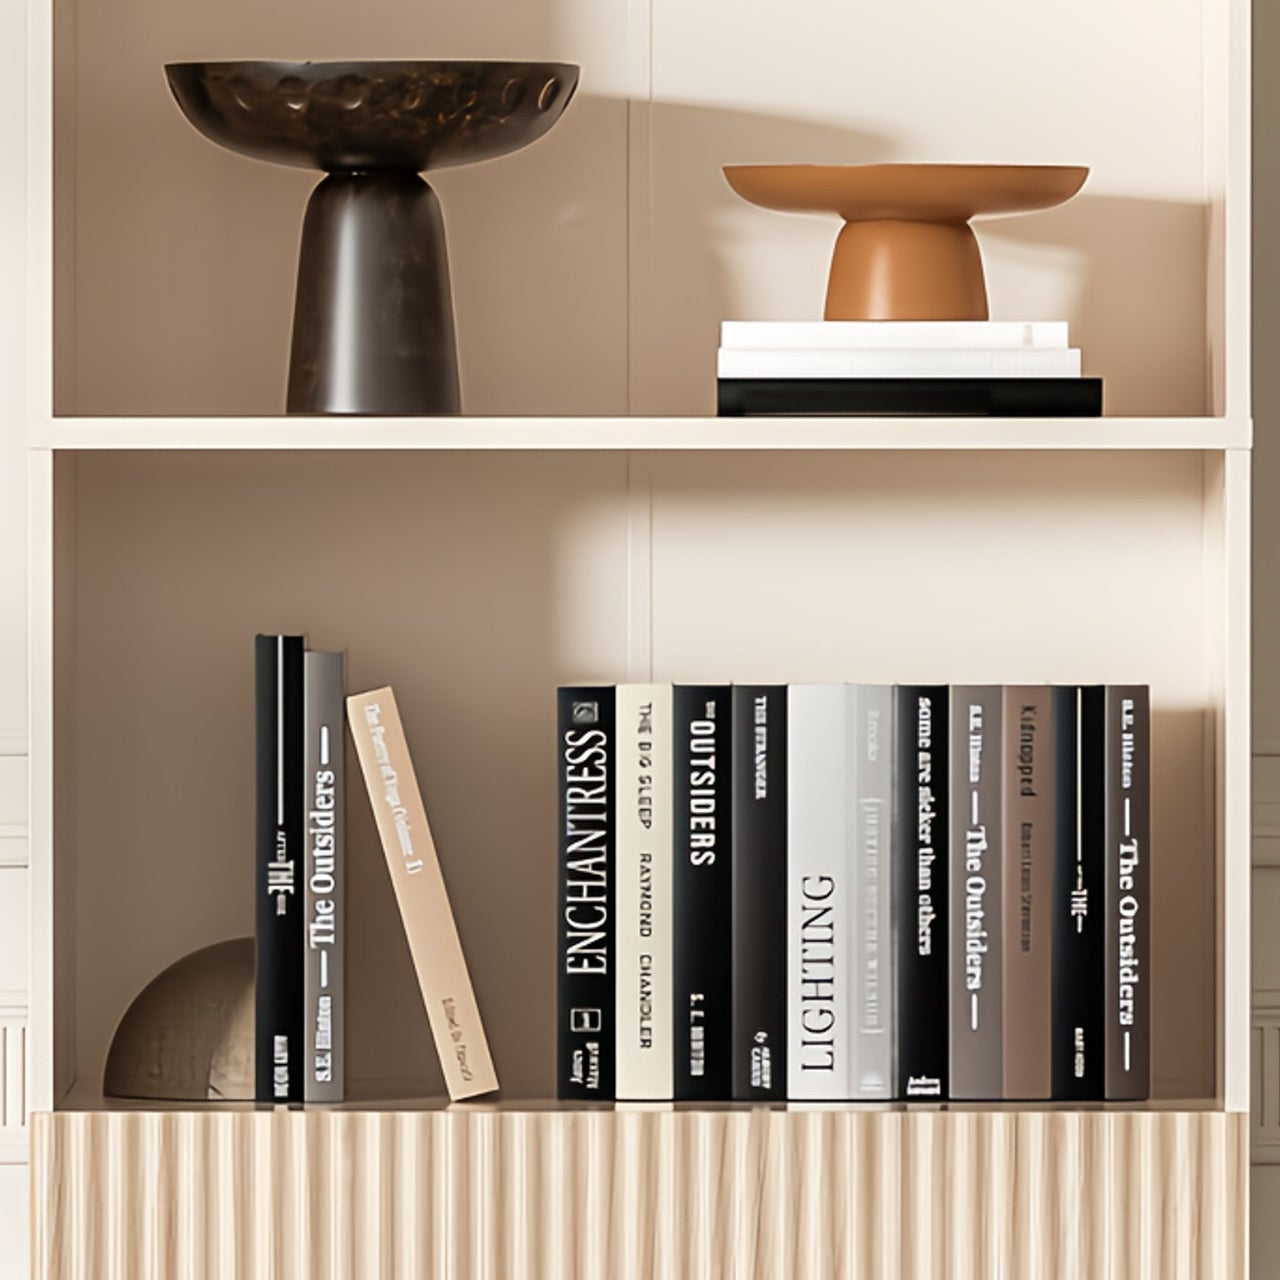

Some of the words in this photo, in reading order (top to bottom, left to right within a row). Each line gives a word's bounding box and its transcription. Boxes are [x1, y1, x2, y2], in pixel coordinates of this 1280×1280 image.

[638, 702, 652, 734] THE
[919, 696, 932, 748] some
[638, 742, 652, 769] BIG
[919, 751, 932, 783] are
[1017, 705, 1037, 798] Kidnapped
[638, 776, 652, 830] SLEEP
[690, 720, 716, 866] OUTSIDERS
[310, 770, 336, 895] Outsiders
[565, 730, 608, 975] ENCHANTRESS
[967, 825, 988, 872] The
[268, 860, 295, 895] THE
[919, 846, 937, 891] than
[1119, 838, 1139, 891] The
[310, 899, 336, 950] The
[638, 853, 652, 938] RAYMOND
[919, 894, 937, 956] others
[967, 876, 988, 990] Outsiders
[801, 874, 835, 1072] LIGHTING
[1119, 895, 1139, 1026] Outsiders
[638, 954, 652, 1049] CHANDLER
